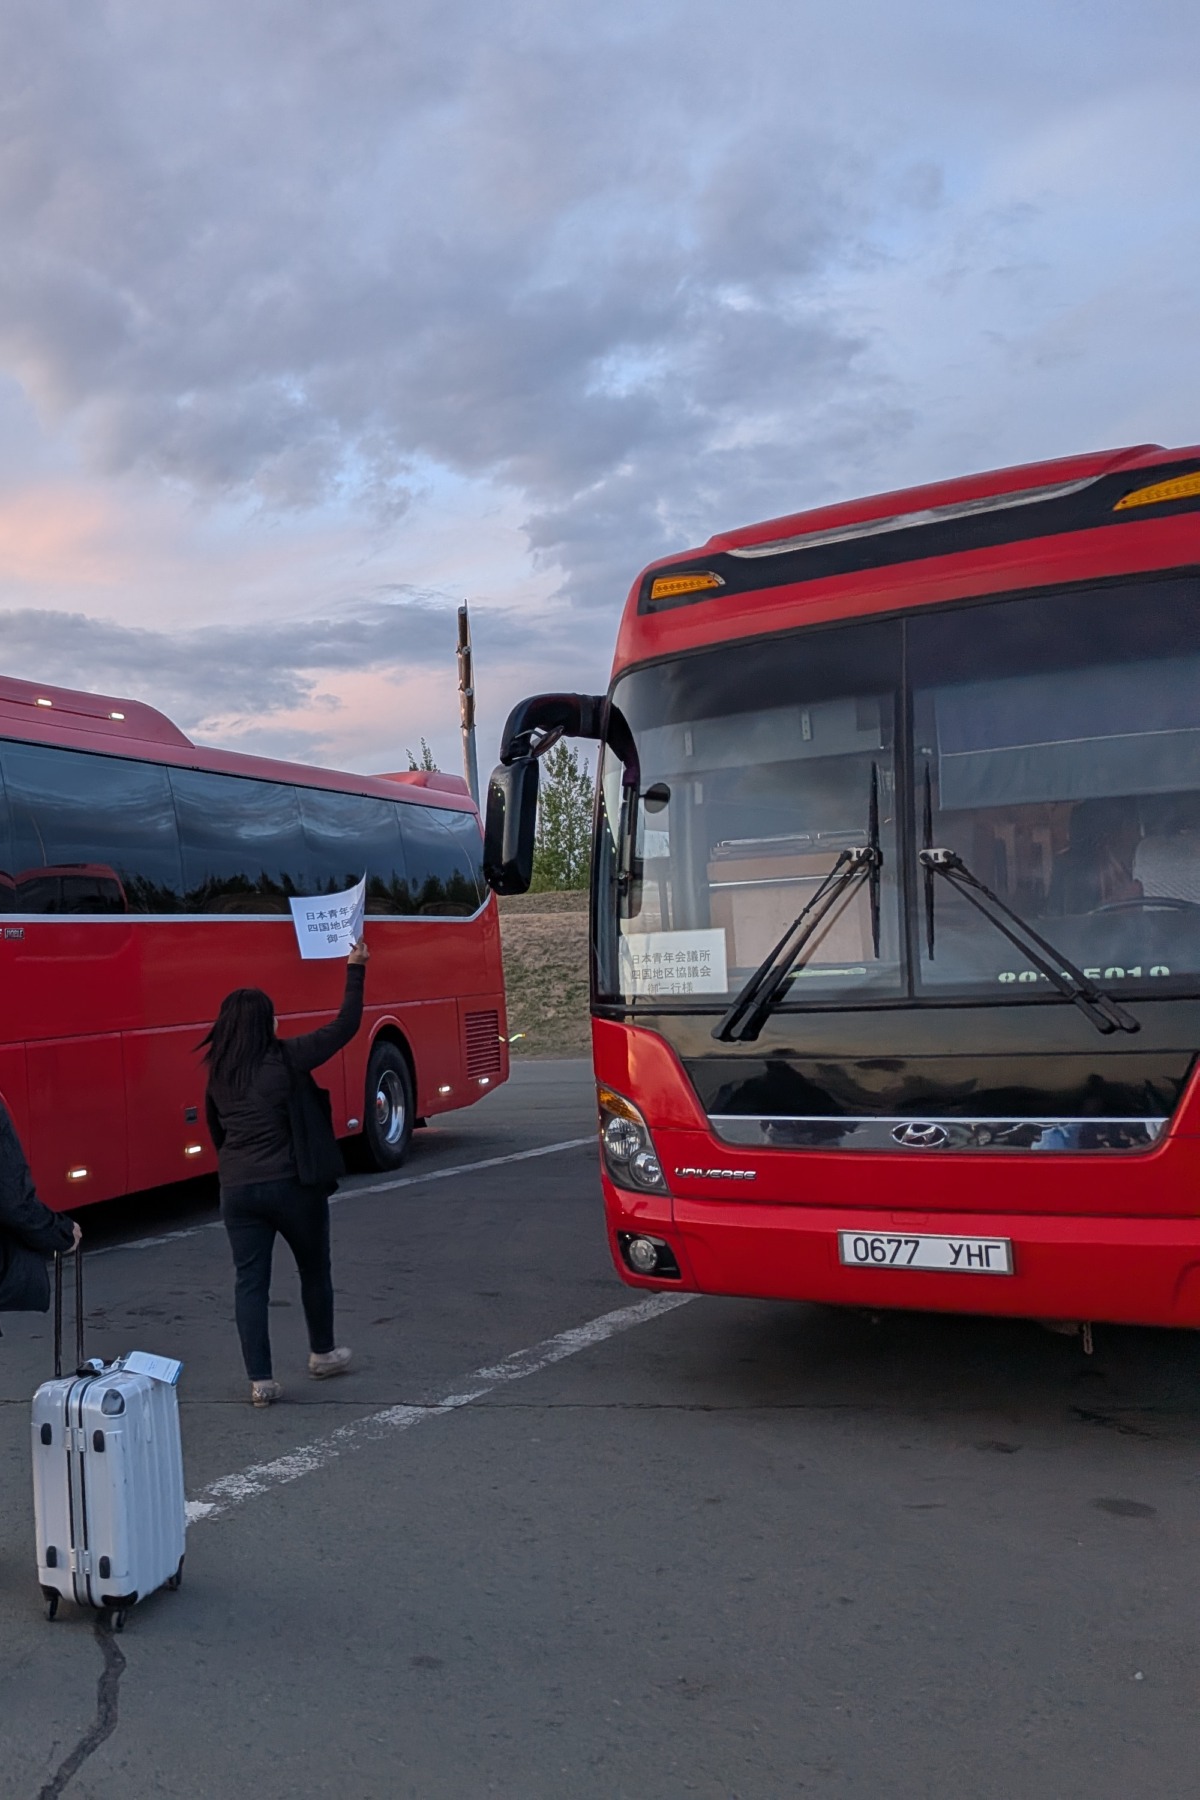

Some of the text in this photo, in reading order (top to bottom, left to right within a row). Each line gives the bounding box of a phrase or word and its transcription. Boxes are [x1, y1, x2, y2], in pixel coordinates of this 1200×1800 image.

[632, 949, 711, 965] 日本青年会議所
[631, 965, 712, 980] 四国地区協議会
[675, 1167, 757, 1180] UNIVERSE
[853, 1236, 1001, 1267] 0677 УНГ
